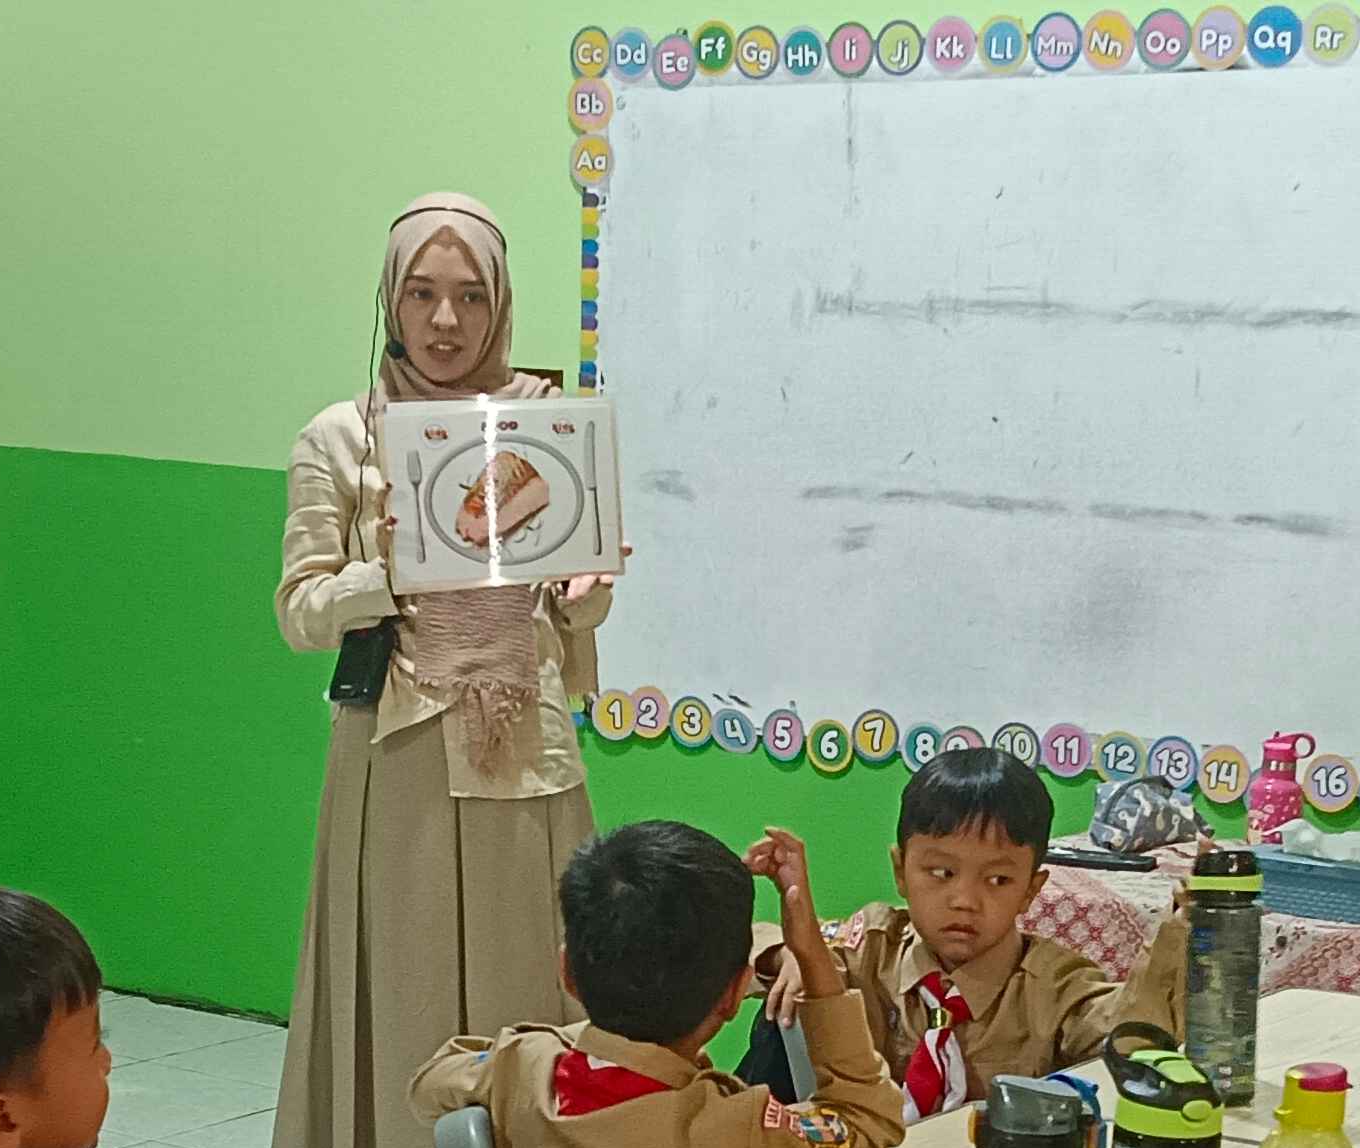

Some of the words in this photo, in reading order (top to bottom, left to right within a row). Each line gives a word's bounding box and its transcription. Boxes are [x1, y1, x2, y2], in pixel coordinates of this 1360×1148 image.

[577, 43, 602, 64] Cc
[616, 43, 646, 65] Dd
[662, 52, 689, 73] Ee
[700, 37, 726, 59] Ff
[742, 42, 772, 70] Gg
[787, 47, 818, 69] Hh
[890, 40, 910, 69] Jj
[935, 37, 966, 60] Kk
[990, 37, 1013, 60] Ll
[1037, 37, 1074, 56] Mm
[1090, 31, 1123, 59] Nn
[1145, 30, 1181, 55] Oo
[1200, 28, 1233, 57] Pp
[1253, 25, 1292, 55] Qq
[1314, 26, 1344, 50] Rr
[576, 93, 604, 115] Bb
[577, 151, 607, 171] Aa
[607, 699, 623, 729] 1
[637, 697, 658, 728] 2
[681, 704, 703, 736] 3
[723, 717, 747, 745] 4
[773, 716, 792, 750] 5
[820, 730, 839, 760] 6
[863, 718, 885, 752] 7
[913, 732, 937, 765] 8
[998, 731, 1033, 761] 10
[1052, 736, 1080, 766] 11
[1103, 742, 1137, 773] 12
[1157, 748, 1189, 780] 13
[1204, 760, 1239, 792] 14
[1312, 766, 1348, 797] 16
